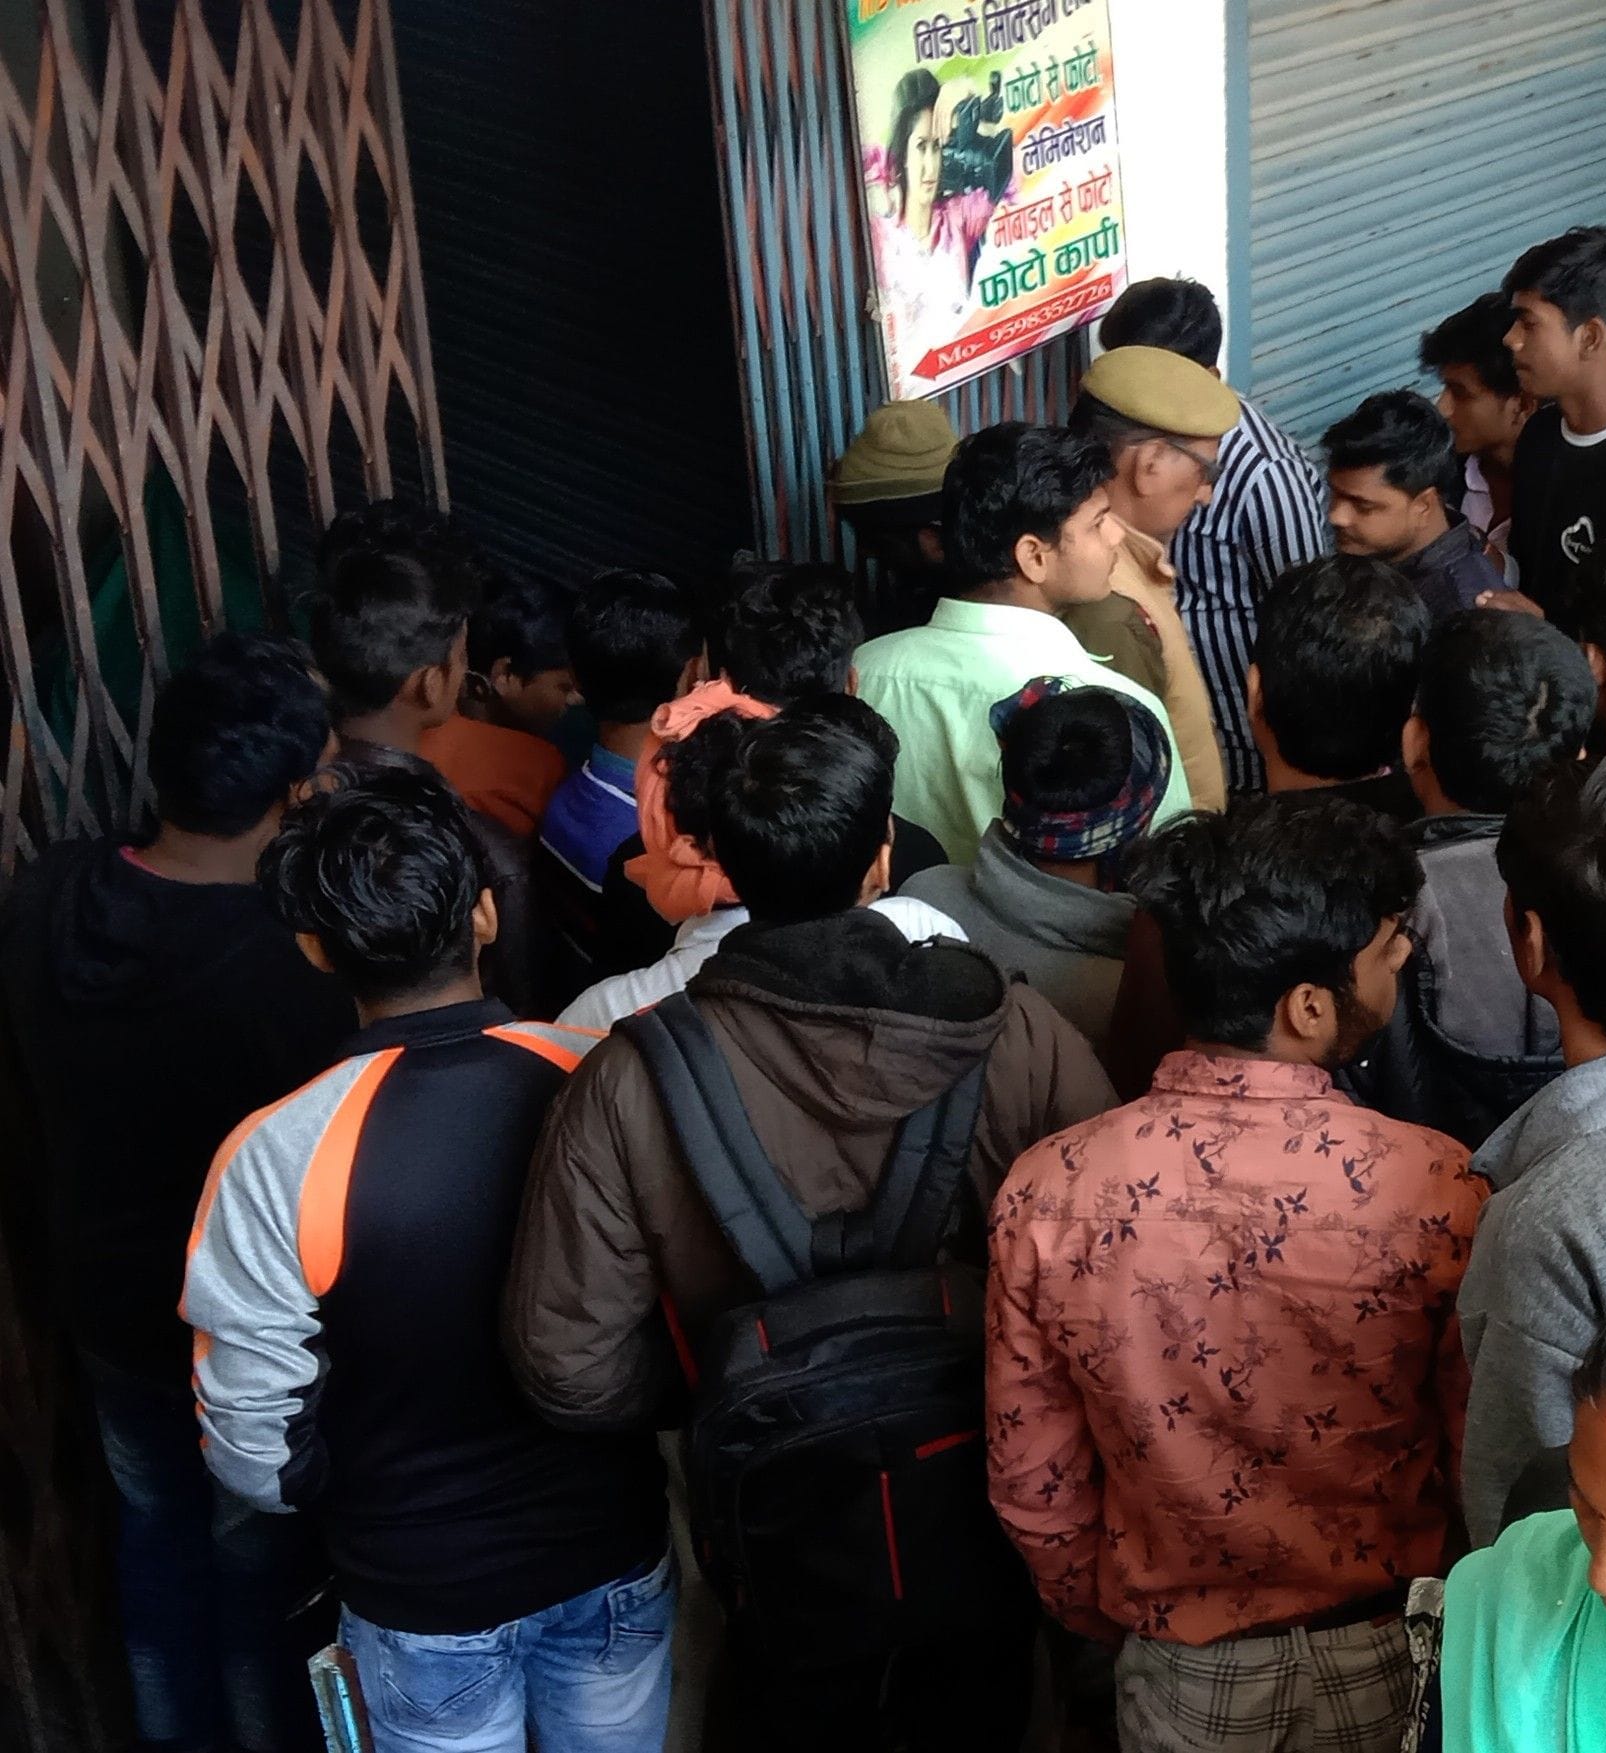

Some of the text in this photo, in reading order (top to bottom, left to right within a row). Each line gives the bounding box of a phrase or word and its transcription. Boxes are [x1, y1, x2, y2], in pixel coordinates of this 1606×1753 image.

[1004, 60, 1042, 113] फोटो
[1063, 40, 1100, 91] फोटो
[1020, 115, 1107, 176] लेमिनेशन
[992, 163, 1114, 249] मोबाइल से फोटो
[978, 248, 1048, 308] फोटो
[988, 282, 1112, 344] 9598352726
